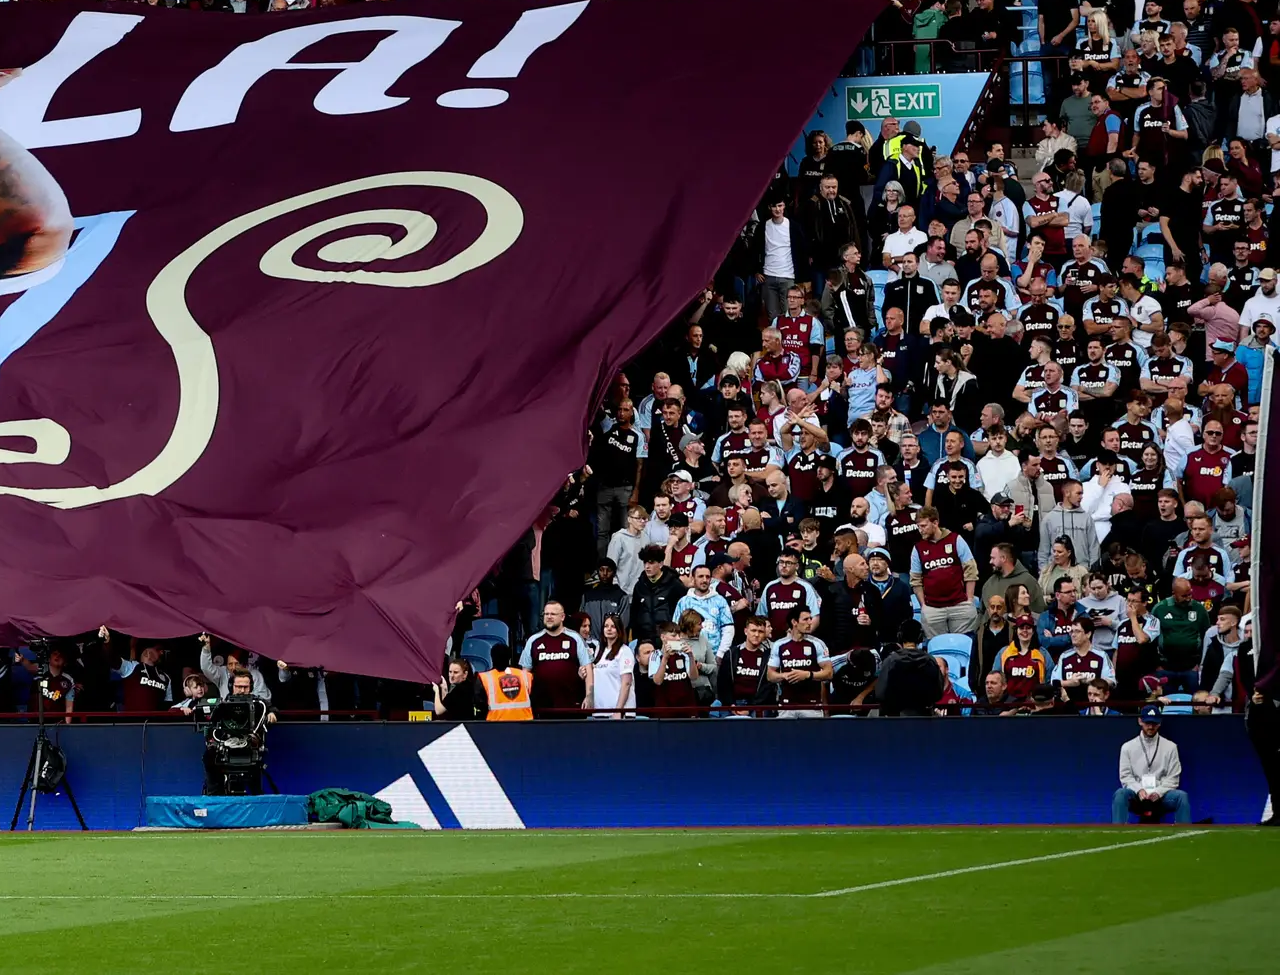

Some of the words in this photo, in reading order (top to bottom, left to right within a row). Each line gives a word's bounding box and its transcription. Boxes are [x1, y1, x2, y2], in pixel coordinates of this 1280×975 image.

[894, 92, 936, 111] EXIT
[608, 438, 631, 452] Betano
[1200, 466, 1222, 475] BK8
[1044, 472, 1067, 480] etano
[925, 558, 954, 570] CAZOO
[771, 602, 797, 610] Betano
[539, 652, 569, 660] Betano
[783, 659, 812, 667] Betano
[1012, 667, 1034, 676] BK8
